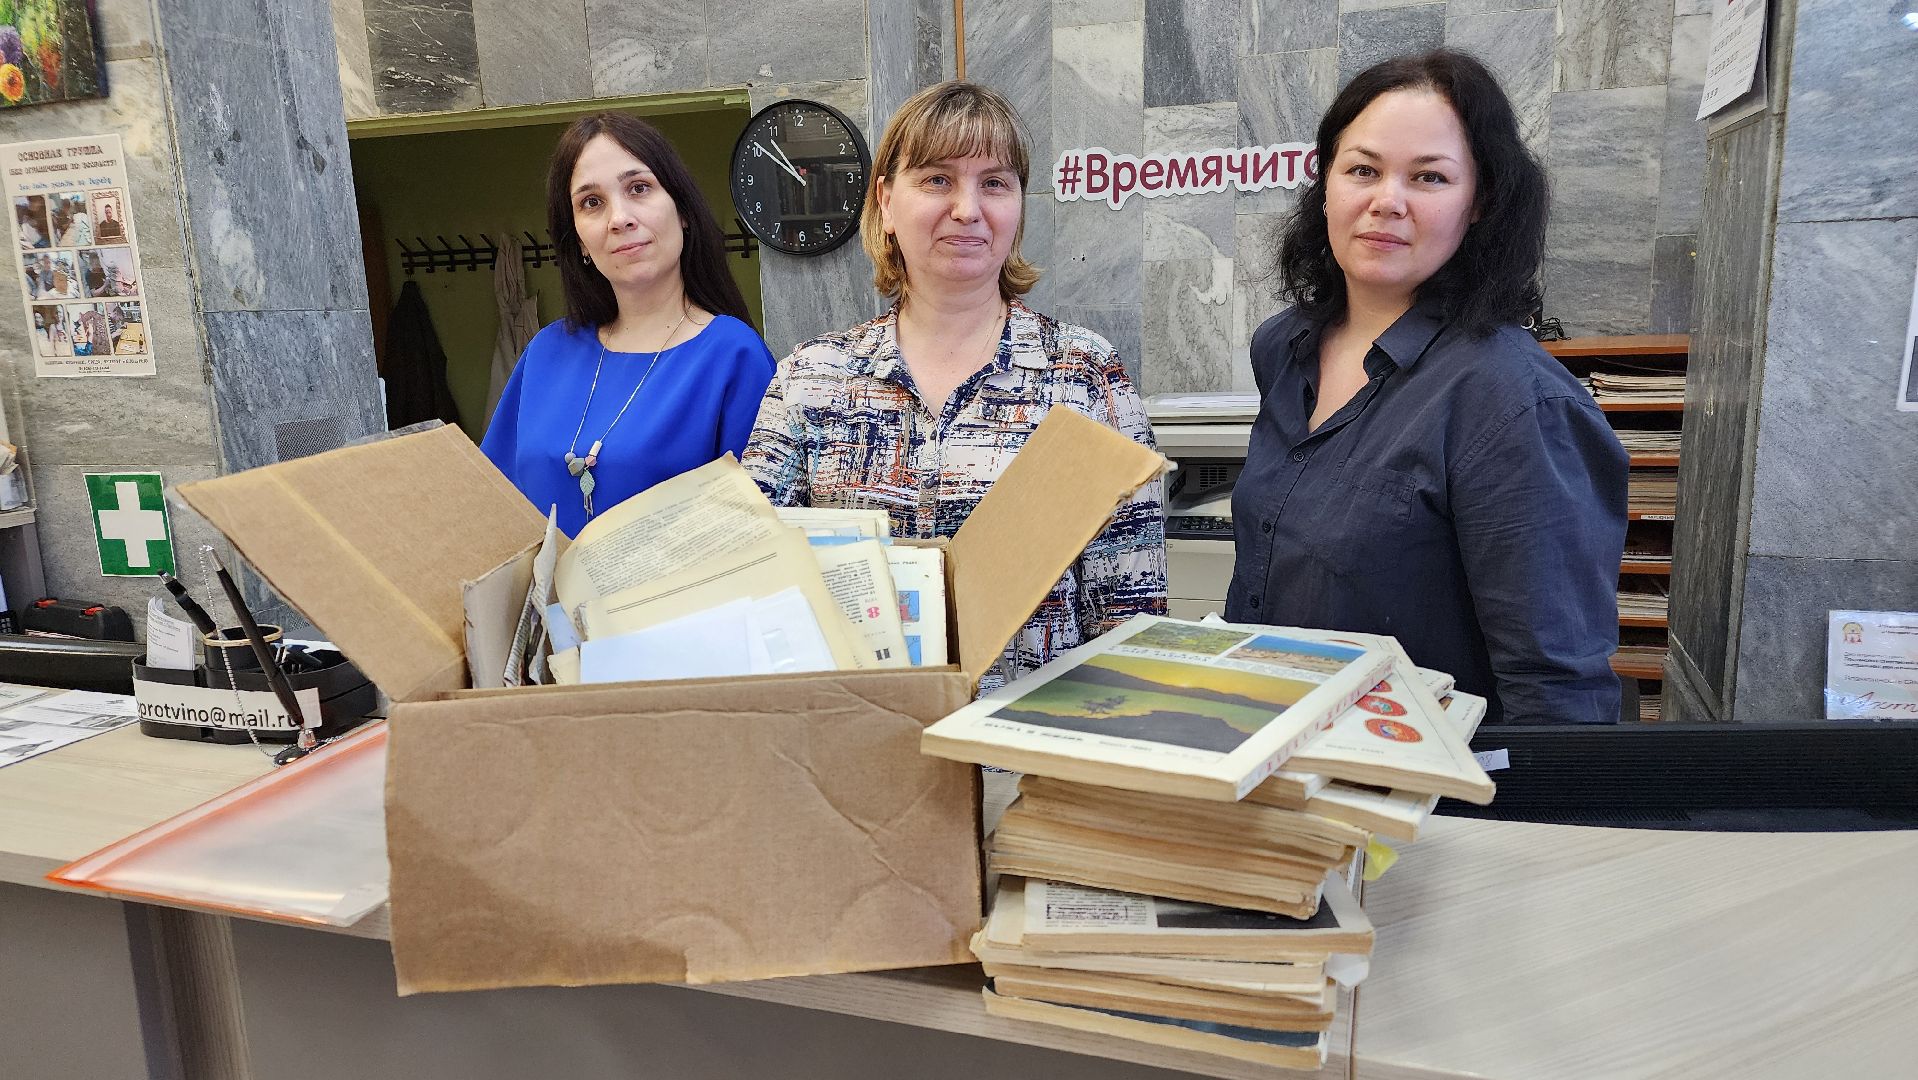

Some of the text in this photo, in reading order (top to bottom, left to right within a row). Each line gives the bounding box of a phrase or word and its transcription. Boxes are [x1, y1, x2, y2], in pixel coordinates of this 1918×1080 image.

[793, 115, 804, 127] 12
[768, 125, 778, 137] 11
[822, 124, 828, 135] 1
[66, 145, 104, 157] ГРУППА
[751, 146, 763, 158] 10
[839, 143, 846, 155] 2
[747, 175, 754, 186] 9
[846, 172, 854, 184] 3
[755, 201, 762, 213] 8
[842, 200, 850, 212] 4
[774, 222, 781, 234] 7
[824, 222, 831, 233] 5
[799, 230, 806, 242] 6
